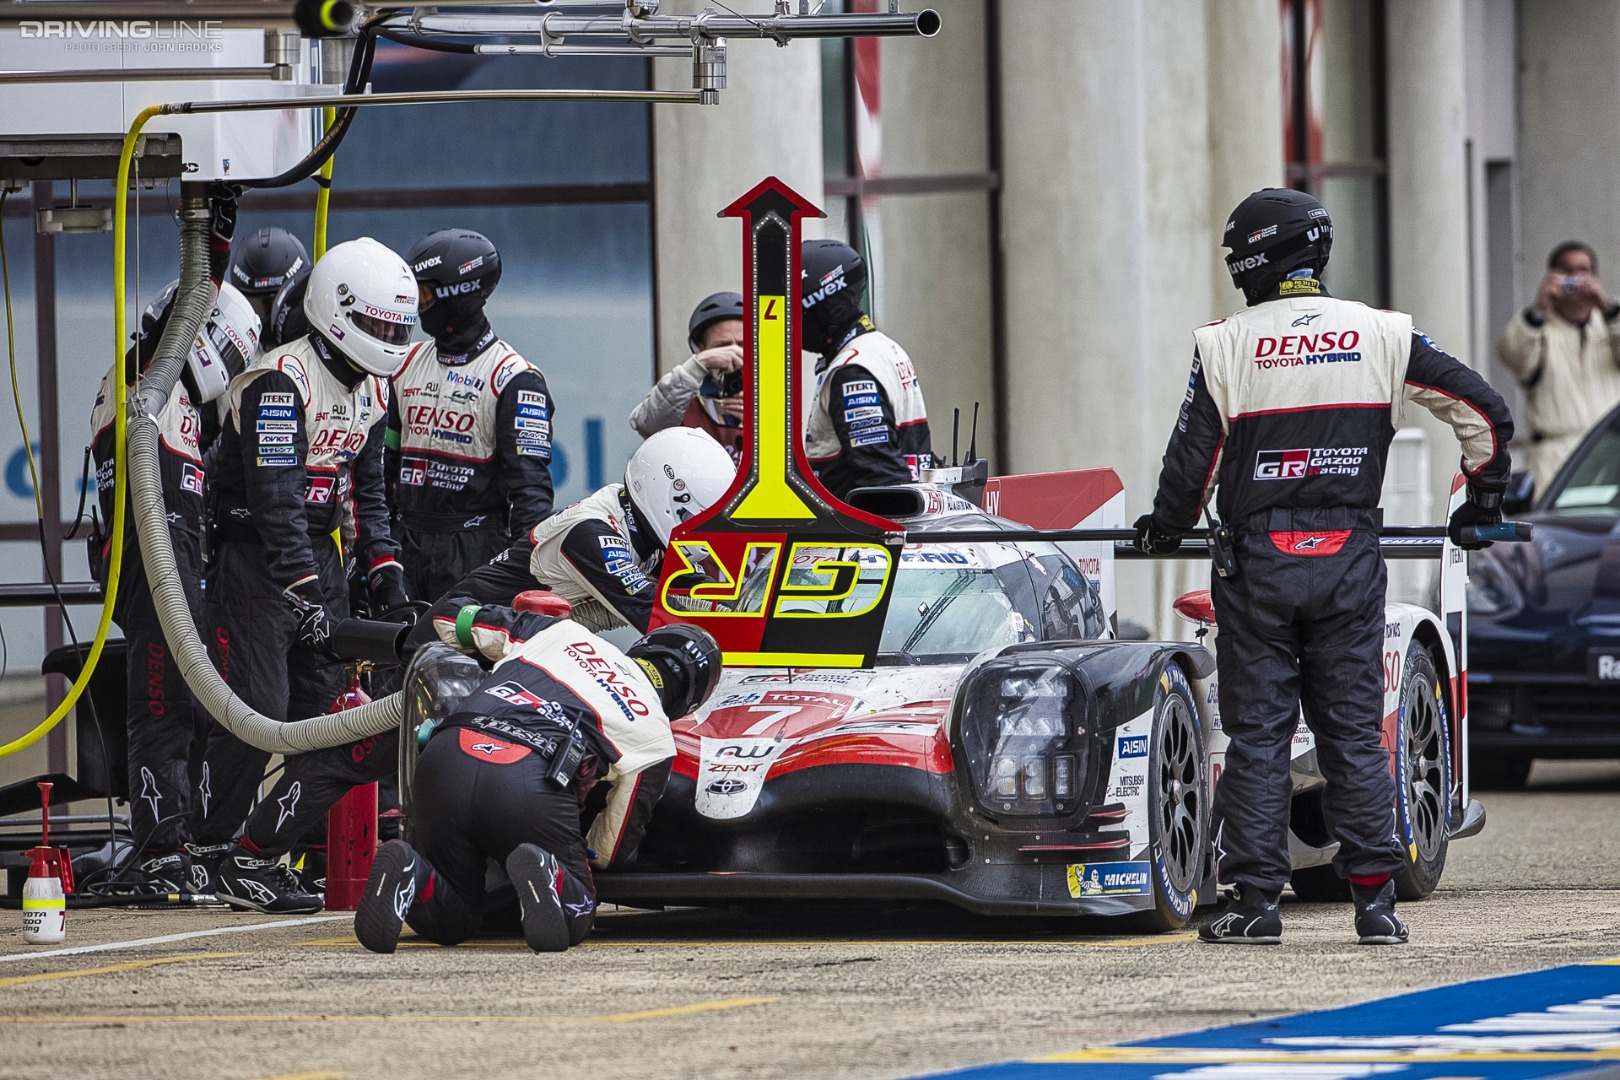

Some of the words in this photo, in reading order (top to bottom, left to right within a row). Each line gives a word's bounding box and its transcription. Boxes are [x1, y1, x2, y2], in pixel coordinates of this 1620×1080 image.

[1248, 233, 1261, 244] GR
[415, 256, 442, 272] uvex
[1229, 252, 1269, 275] uvex
[436, 279, 481, 298] uvex
[802, 276, 847, 308] uvex
[365, 305, 401, 322] TOYOTA
[224, 324, 248, 357] TOYOTA
[1255, 331, 1359, 358] DENSO
[1255, 357, 1304, 370] TOYOTA
[1306, 352, 1361, 365] HYBRID
[447, 371, 475, 386] Mobil
[846, 383, 874, 394] JTEKT
[262, 395, 291, 404] JTEKT
[848, 396, 876, 406] AISIN
[261, 409, 291, 417] AISIN
[315, 412, 329, 422] ENT
[521, 407, 546, 418] AISIN
[409, 426, 429, 436] YOTA
[431, 429, 473, 444] HYBRID
[1313, 447, 1368, 457] TOYOTA
[430, 461, 474, 476] TOYOTA
[1257, 460, 1306, 477] GR
[1311, 457, 1362, 465] GAZOO
[401, 467, 424, 485] GR
[428, 470, 468, 483] GAZOO
[1308, 466, 1359, 476] Racing
[183, 473, 203, 493] GR
[306, 486, 329, 502] R
[607, 550, 630, 559] AISIN
[1079, 558, 1100, 574] TOYOTA
[148, 642, 164, 715] DENSO
[563, 646, 598, 678] TOYOTA
[596, 678, 635, 722] HYBRID
[570, 642, 649, 716] DENSO
[769, 694, 845, 707] TOTAL
[742, 706, 803, 735] 7
[1122, 739, 1146, 755] AISIN
[708, 763, 763, 772] ZENT
[1104, 872, 1147, 886] MICHELIN
